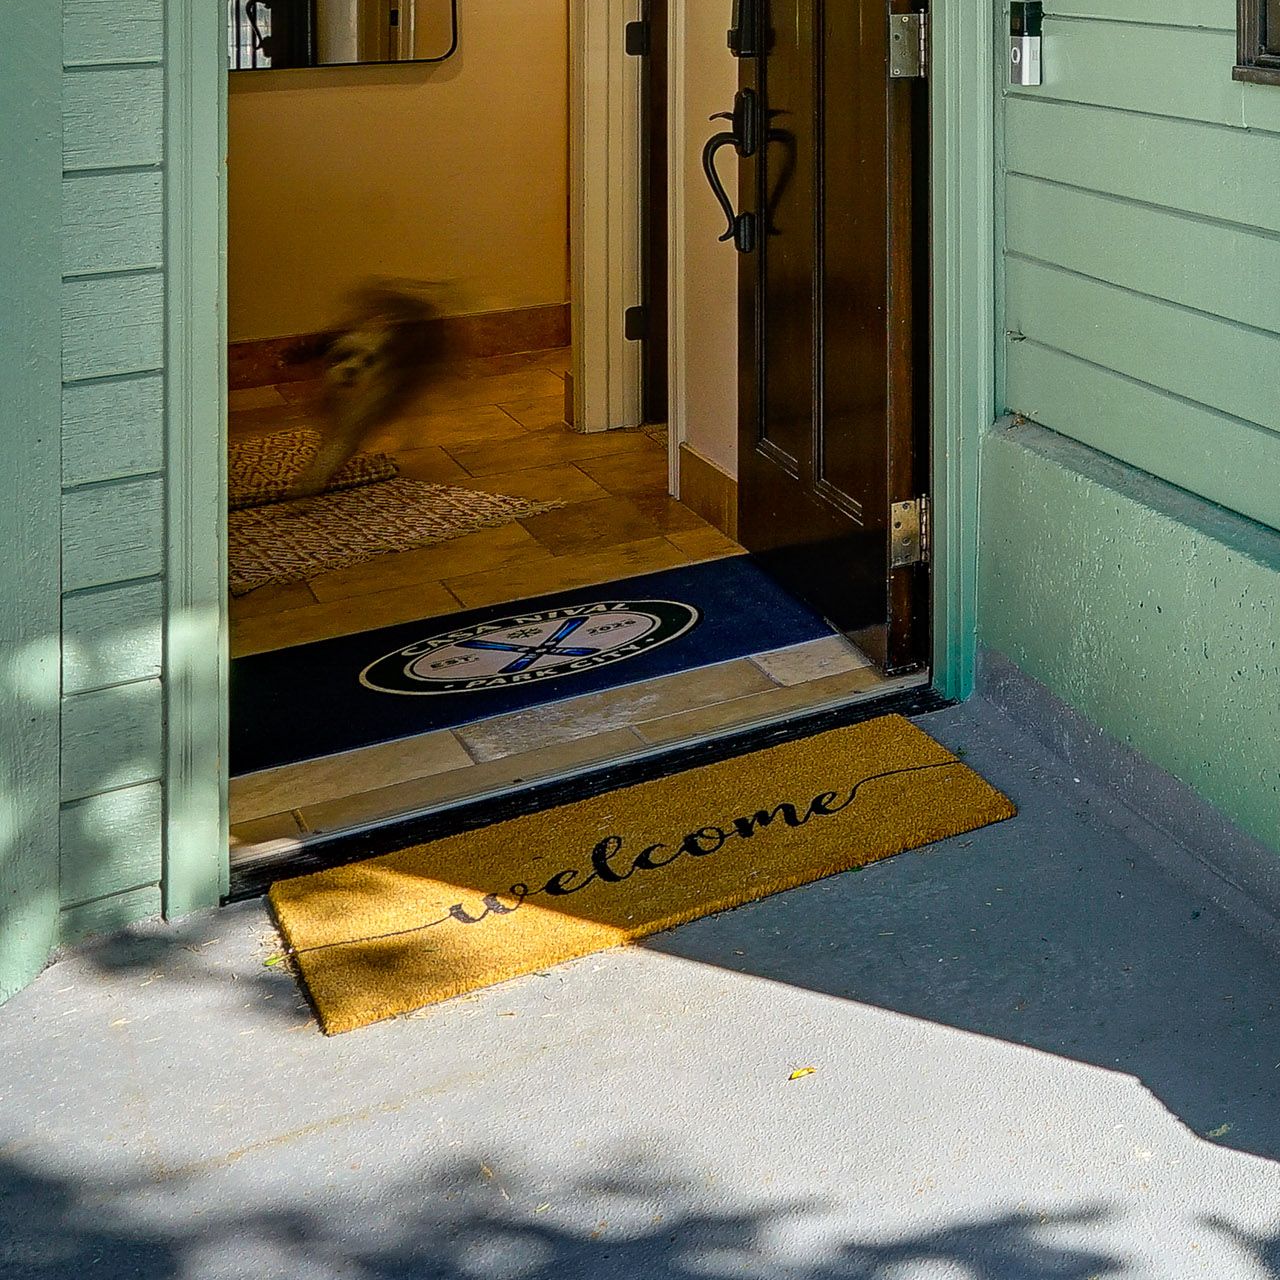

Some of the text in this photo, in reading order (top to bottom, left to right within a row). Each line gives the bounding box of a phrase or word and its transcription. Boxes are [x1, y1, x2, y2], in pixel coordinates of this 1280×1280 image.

[401, 603, 630, 657] CASA NIVAL
[465, 644, 641, 689] PARK CITY
[440, 784, 866, 925] welcome
